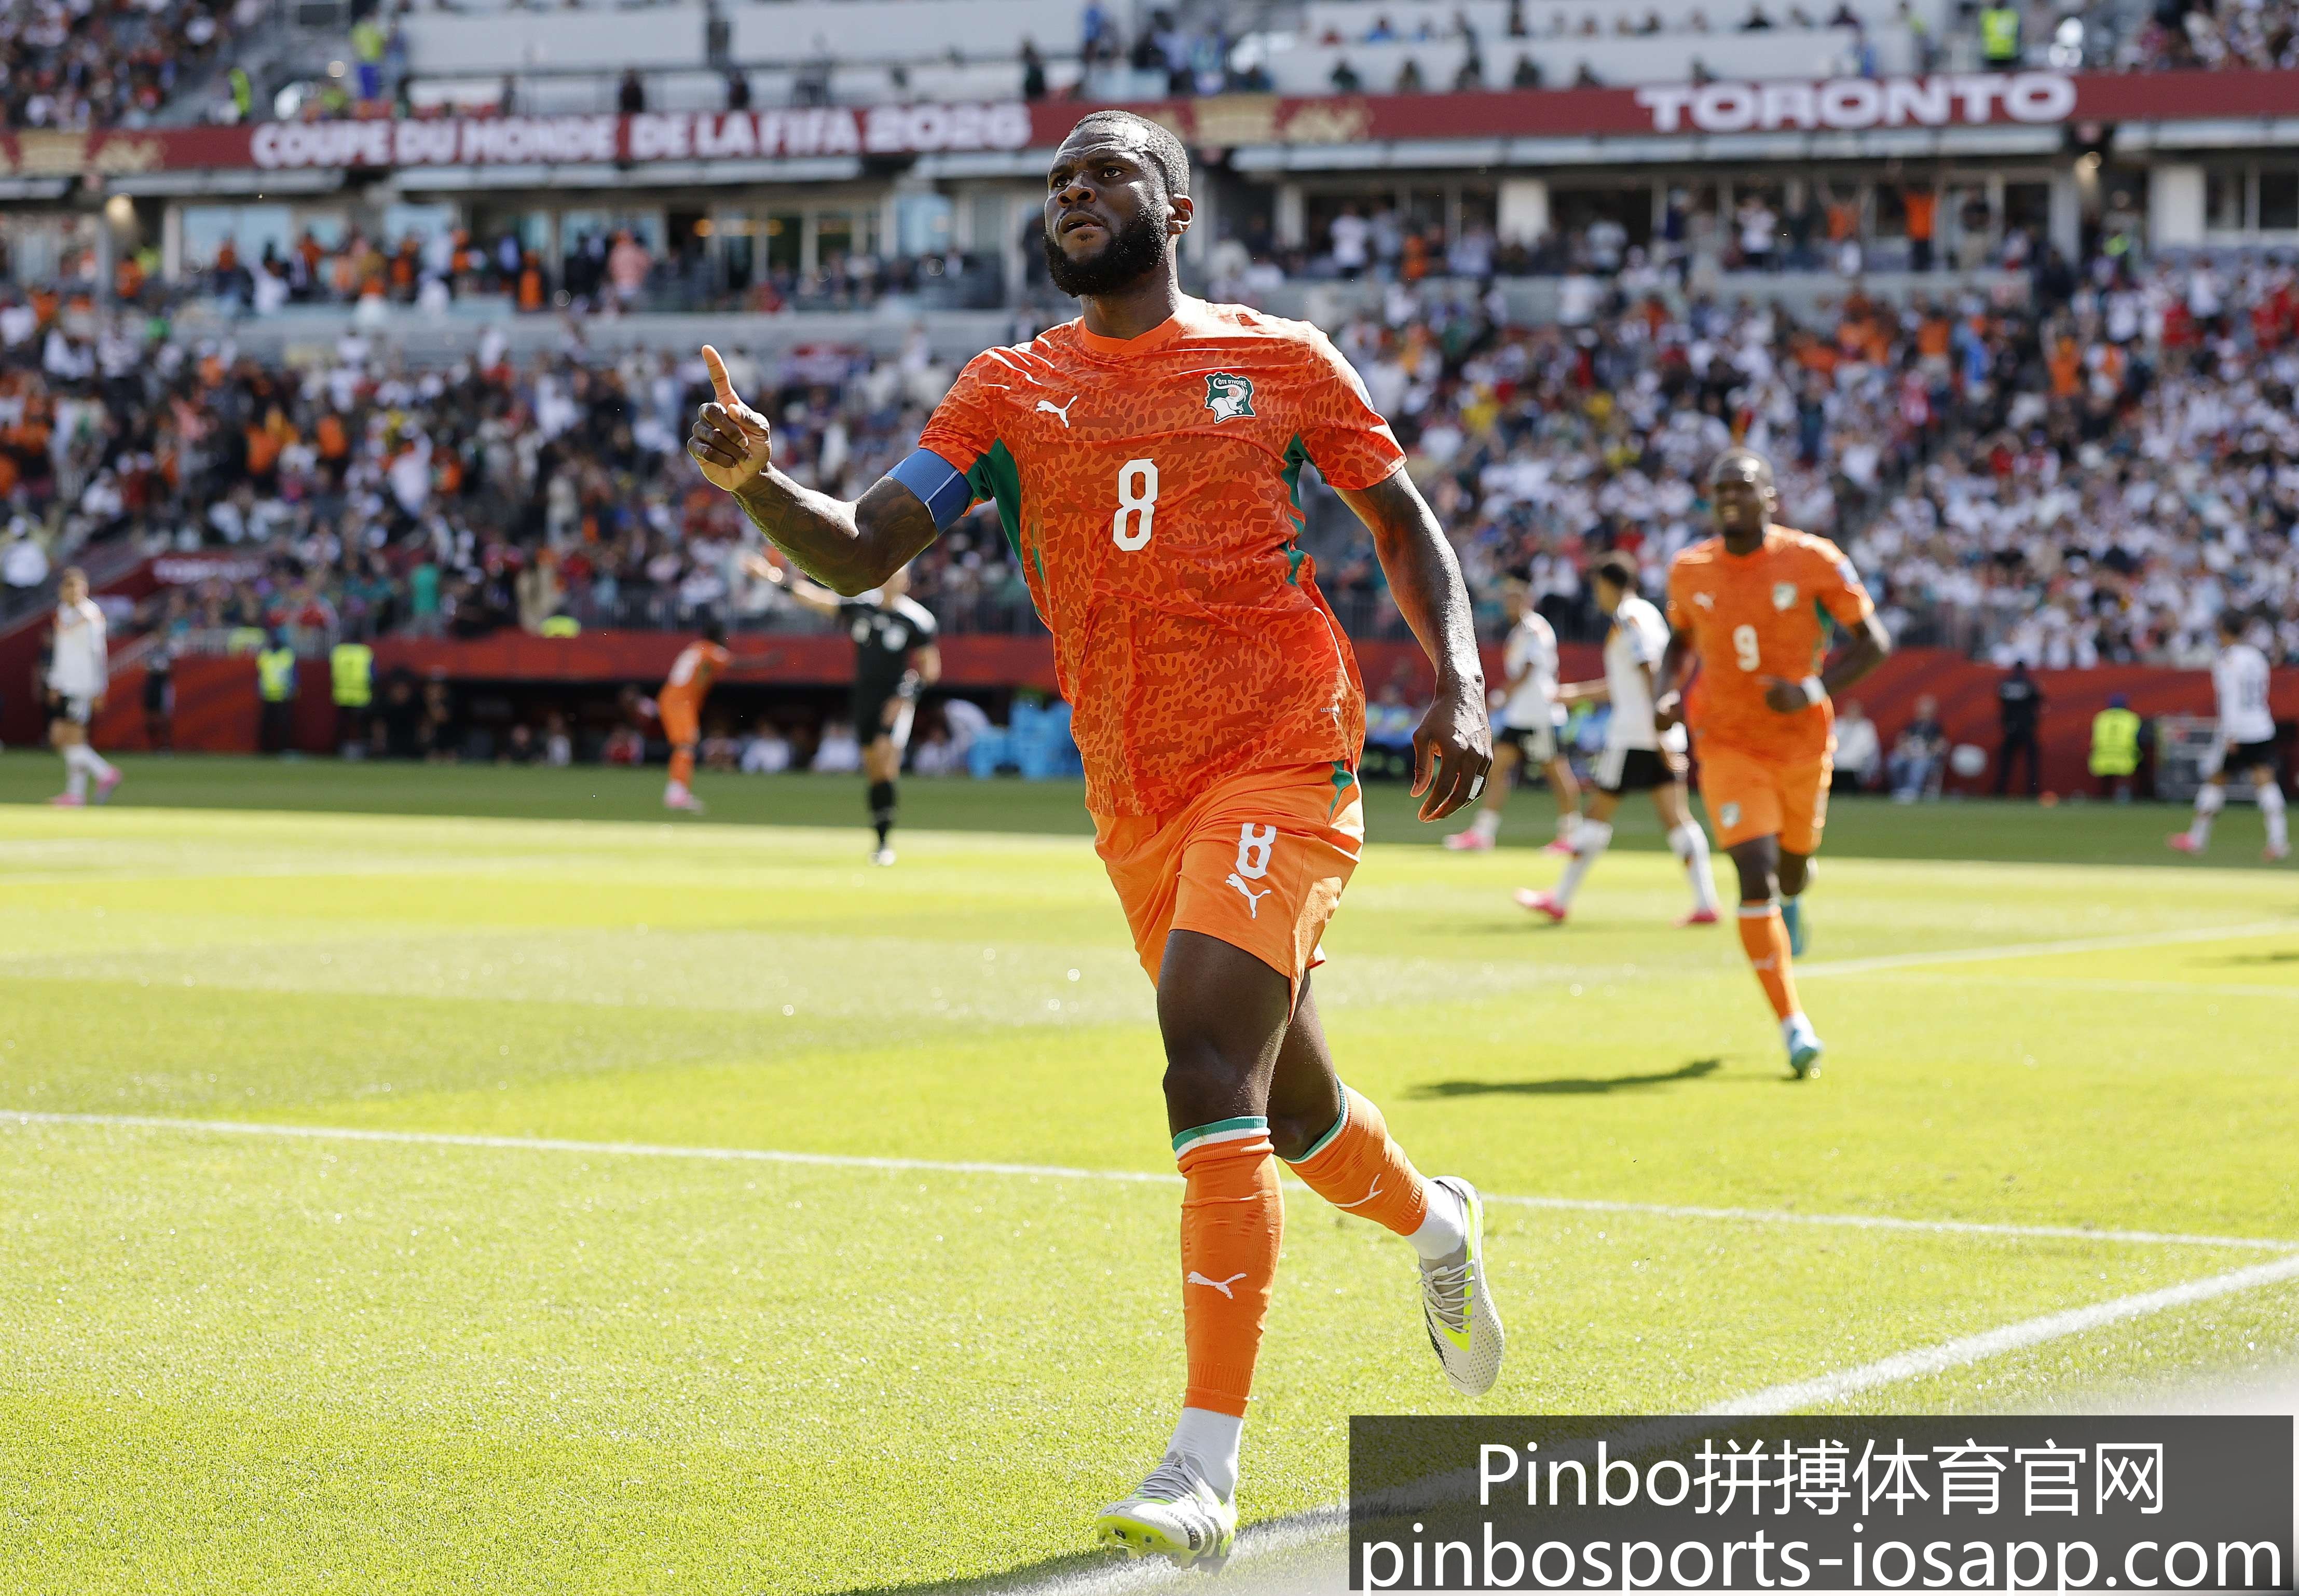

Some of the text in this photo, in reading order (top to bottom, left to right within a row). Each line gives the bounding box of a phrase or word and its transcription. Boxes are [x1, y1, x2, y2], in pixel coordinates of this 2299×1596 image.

[1634, 72, 2076, 132] TORONTO
[250, 103, 1032, 169] COUPE DU MONDE DE LA FIFA 2026
[1113, 458, 1158, 552] 8
[1732, 624, 1761, 672] 9
[1235, 823, 1277, 880] 8
